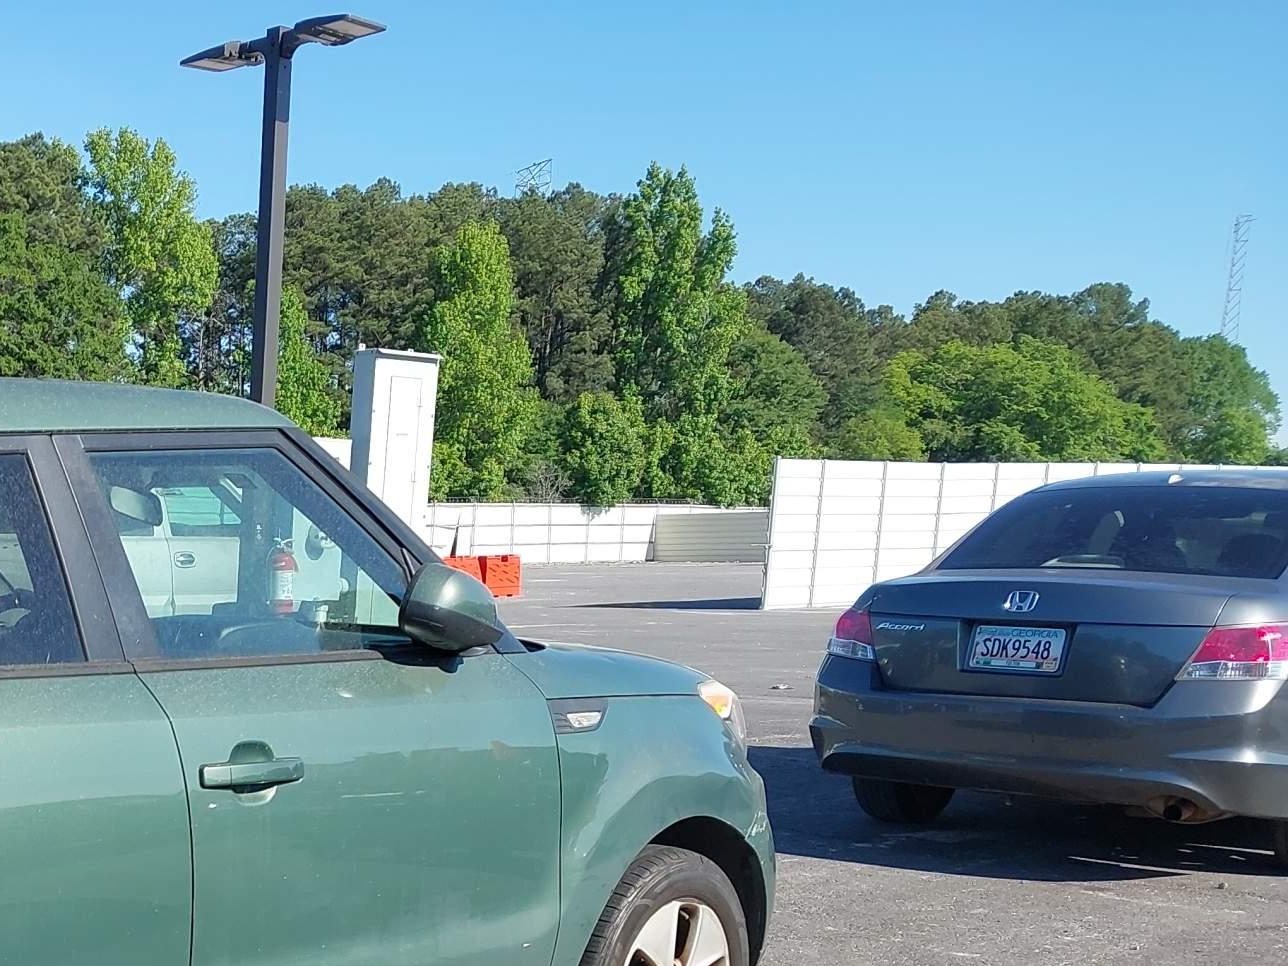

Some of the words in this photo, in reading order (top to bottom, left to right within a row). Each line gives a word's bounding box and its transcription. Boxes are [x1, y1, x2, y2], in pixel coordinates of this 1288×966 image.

[876, 622, 925, 631] Accord
[1012, 628, 1058, 639] GEORGIA
[981, 637, 1052, 660] SDK9548
